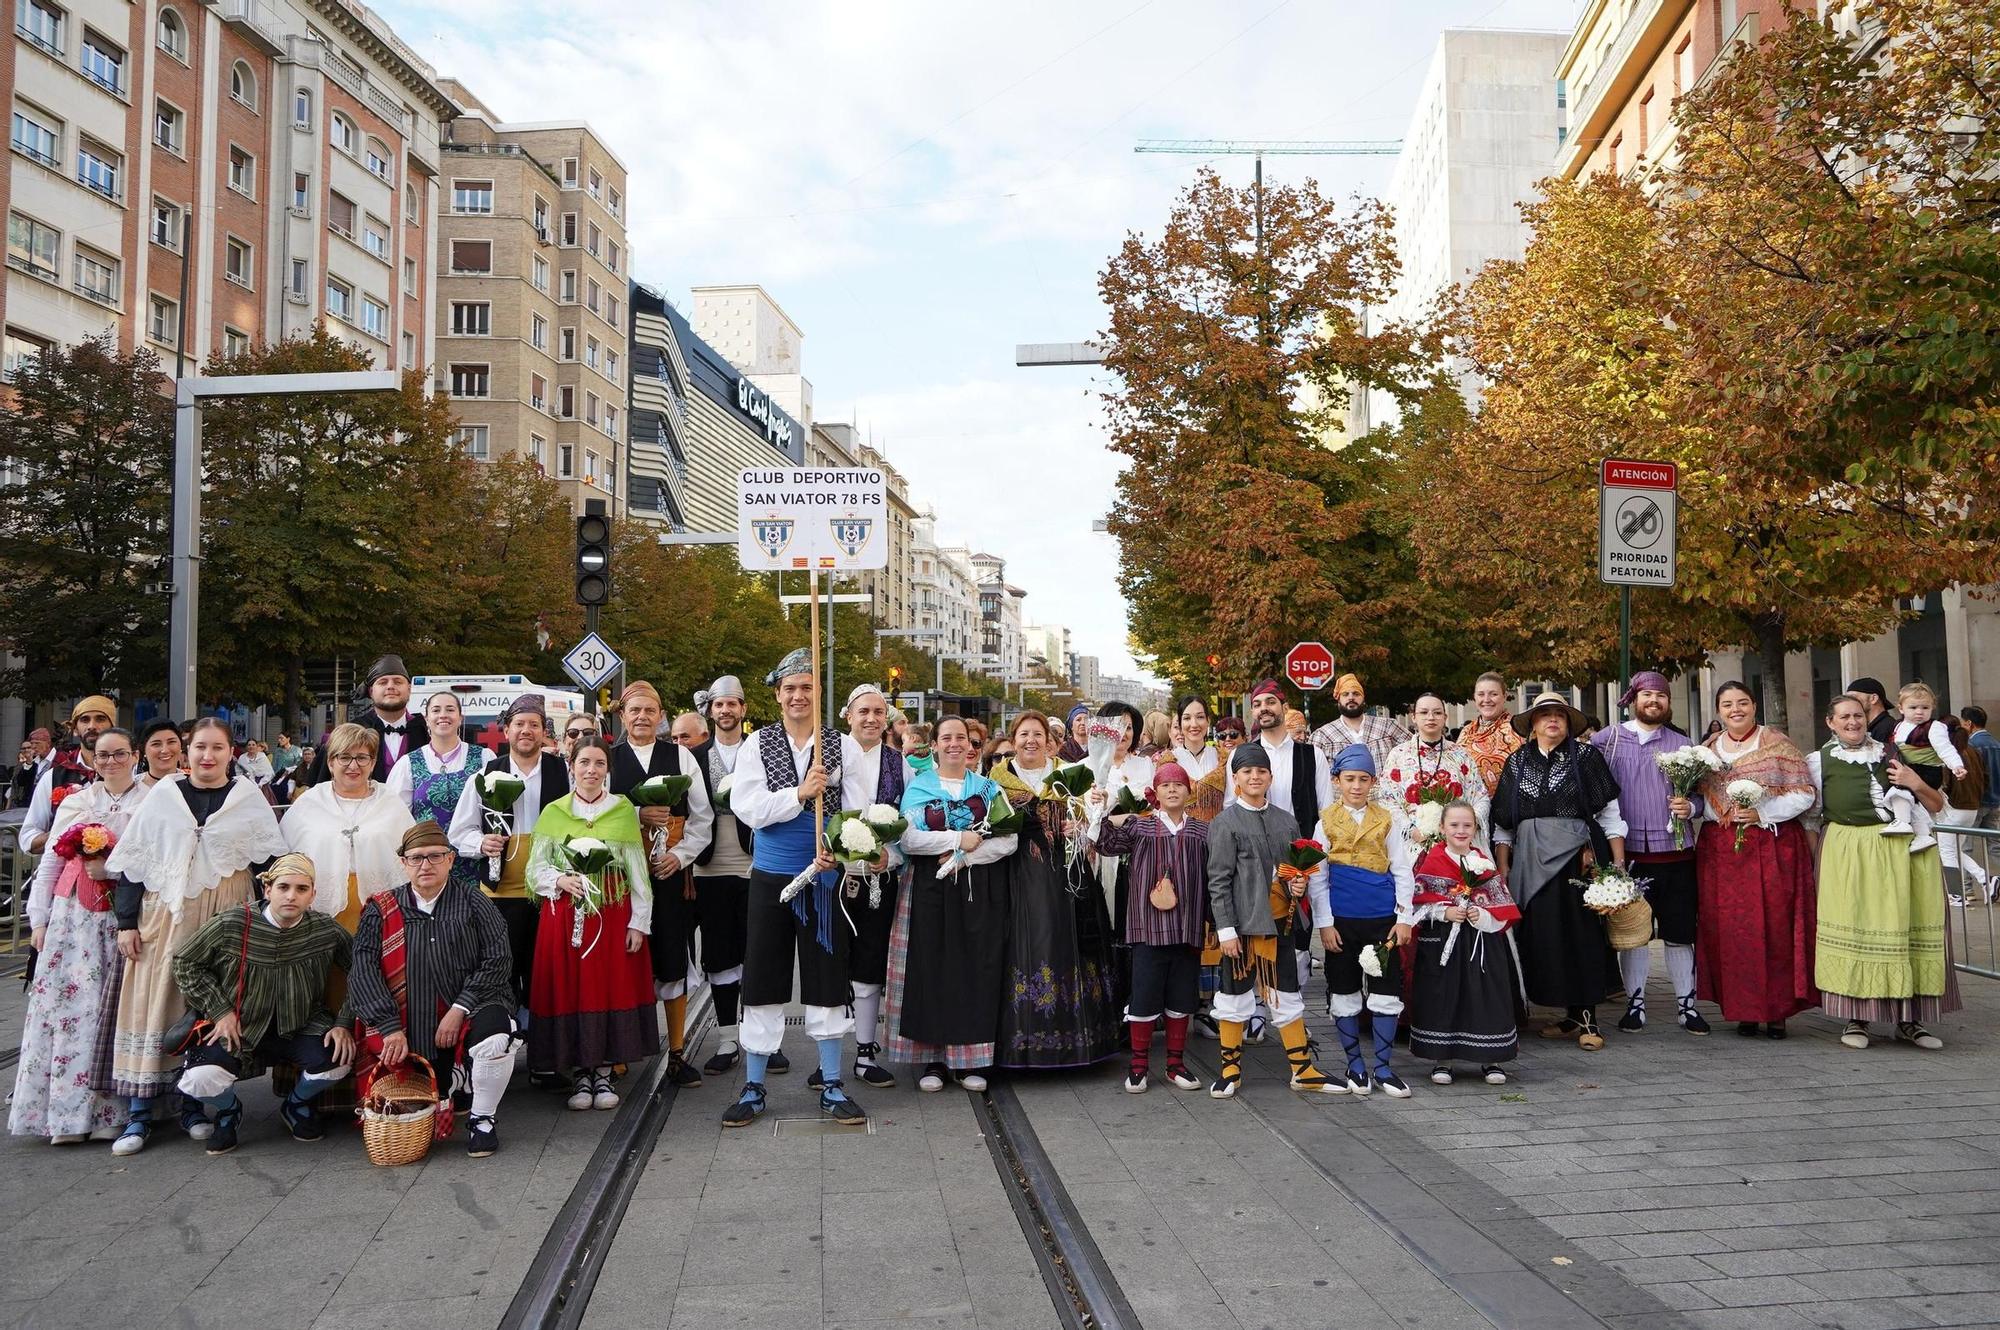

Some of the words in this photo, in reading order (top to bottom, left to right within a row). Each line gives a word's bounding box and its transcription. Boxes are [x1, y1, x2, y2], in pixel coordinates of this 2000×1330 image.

[743, 472, 785, 484] CLUB
[793, 472, 881, 484] DEPORTIVO
[1612, 469, 1668, 481] ATENCIÓN
[744, 493, 776, 505] SAN
[780, 493, 837, 505] VIATOR
[841, 493, 858, 505] 78
[862, 493, 881, 505] FS
[1621, 510, 1658, 535] 20
[1610, 552, 1668, 564] PRIORIDAD
[1611, 567, 1667, 578] PEATONAL
[579, 651, 606, 671] 30
[1292, 661, 1329, 671] STOP
[420, 696, 510, 707] ALANCIA
